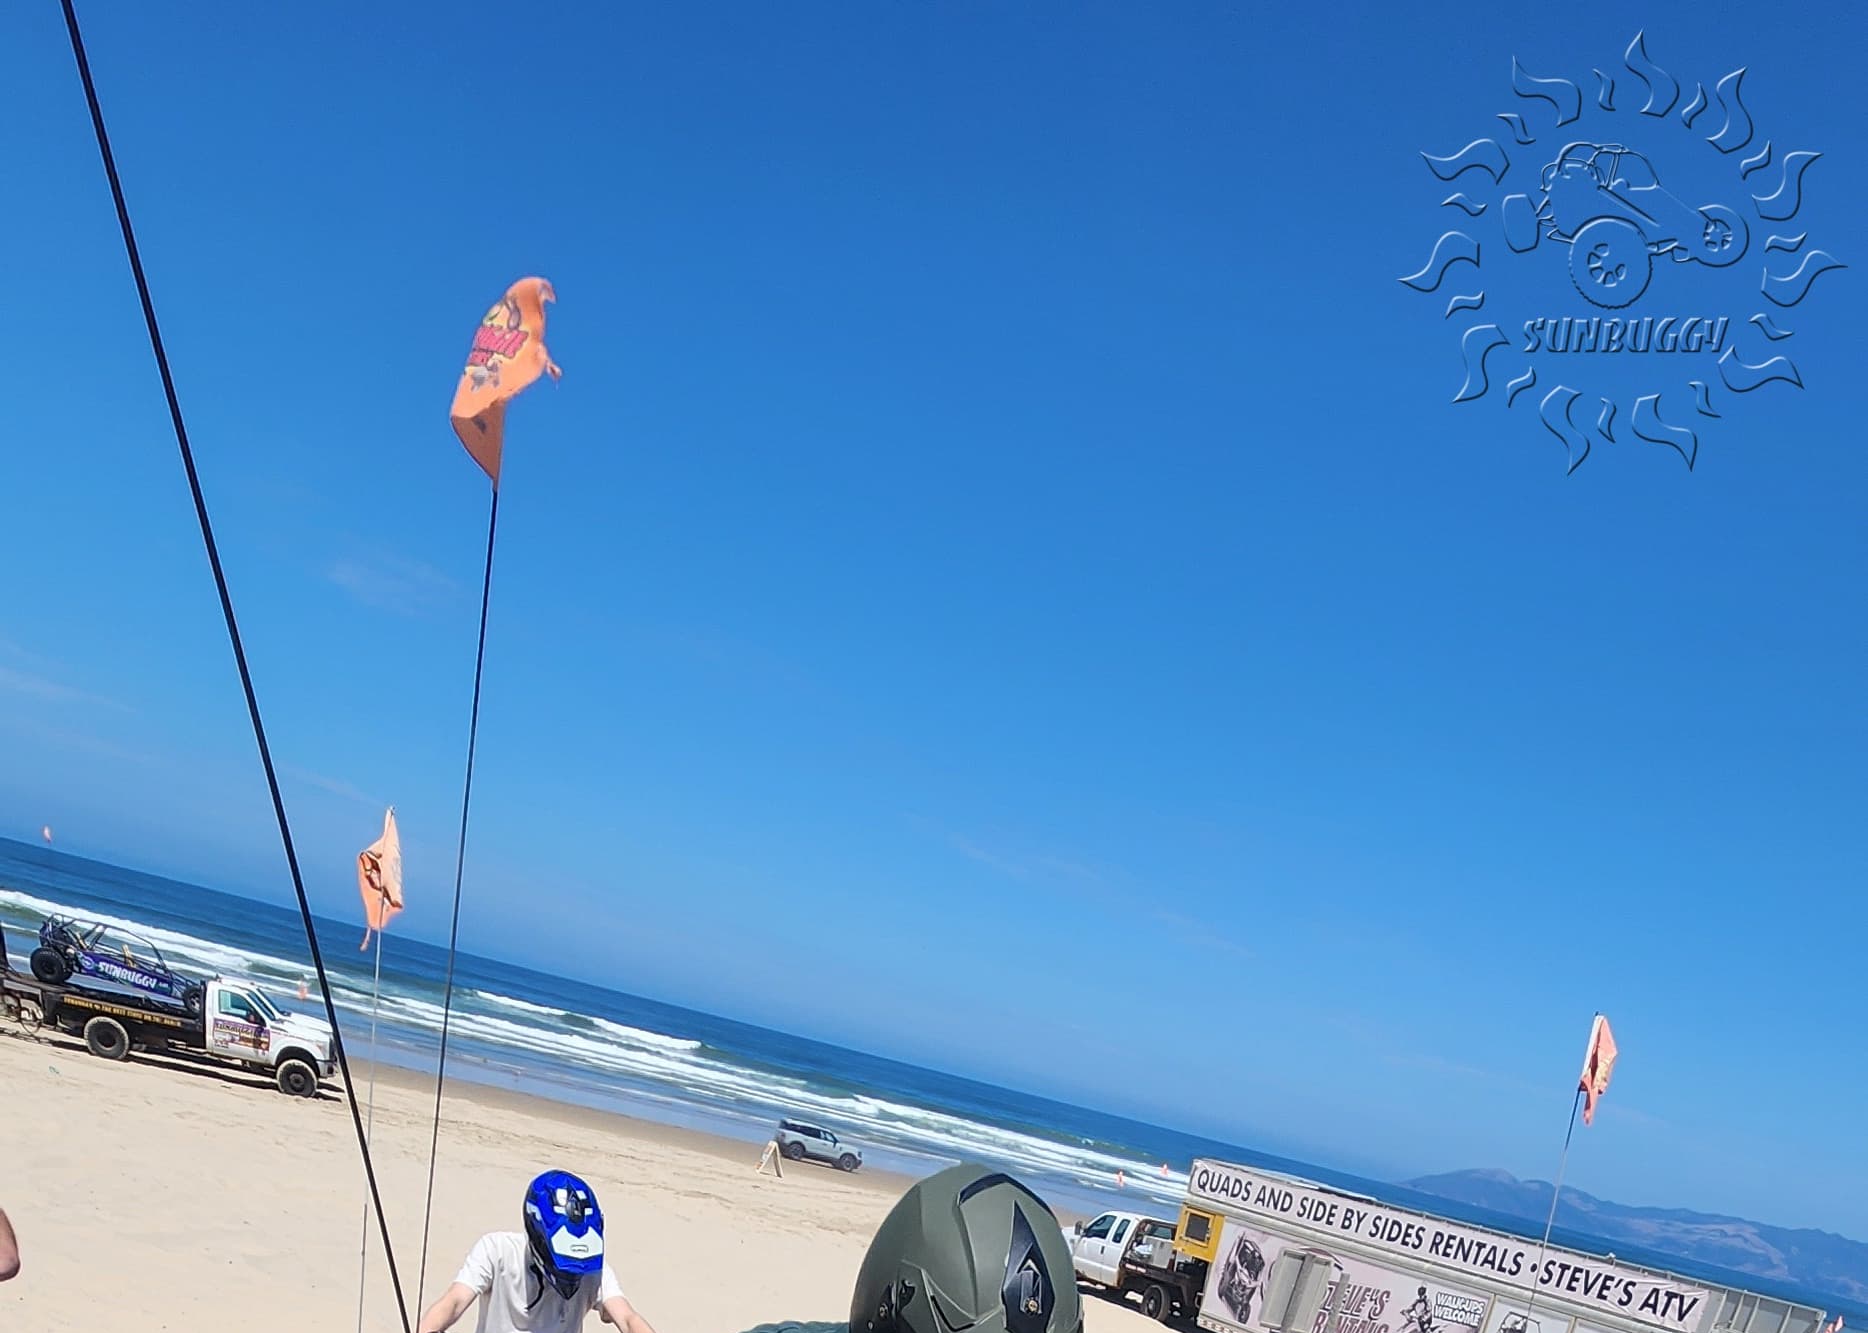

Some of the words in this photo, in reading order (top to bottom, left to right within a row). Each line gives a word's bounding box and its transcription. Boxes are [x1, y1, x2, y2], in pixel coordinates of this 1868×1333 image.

[98, 962, 158, 988] SUNBUGGY
[1197, 1169, 1253, 1202] QUADS
[1254, 1185, 1294, 1213] AND
[1297, 1196, 1338, 1226] SIDE
[1341, 1208, 1369, 1234] BY
[1368, 1215, 1426, 1250] SIDES
[1428, 1230, 1525, 1276] RENTALS
[1539, 1259, 1637, 1307] STEVE'S
[1638, 1287, 1700, 1323] ATV
[1434, 1306, 1484, 1328] WELCOME
